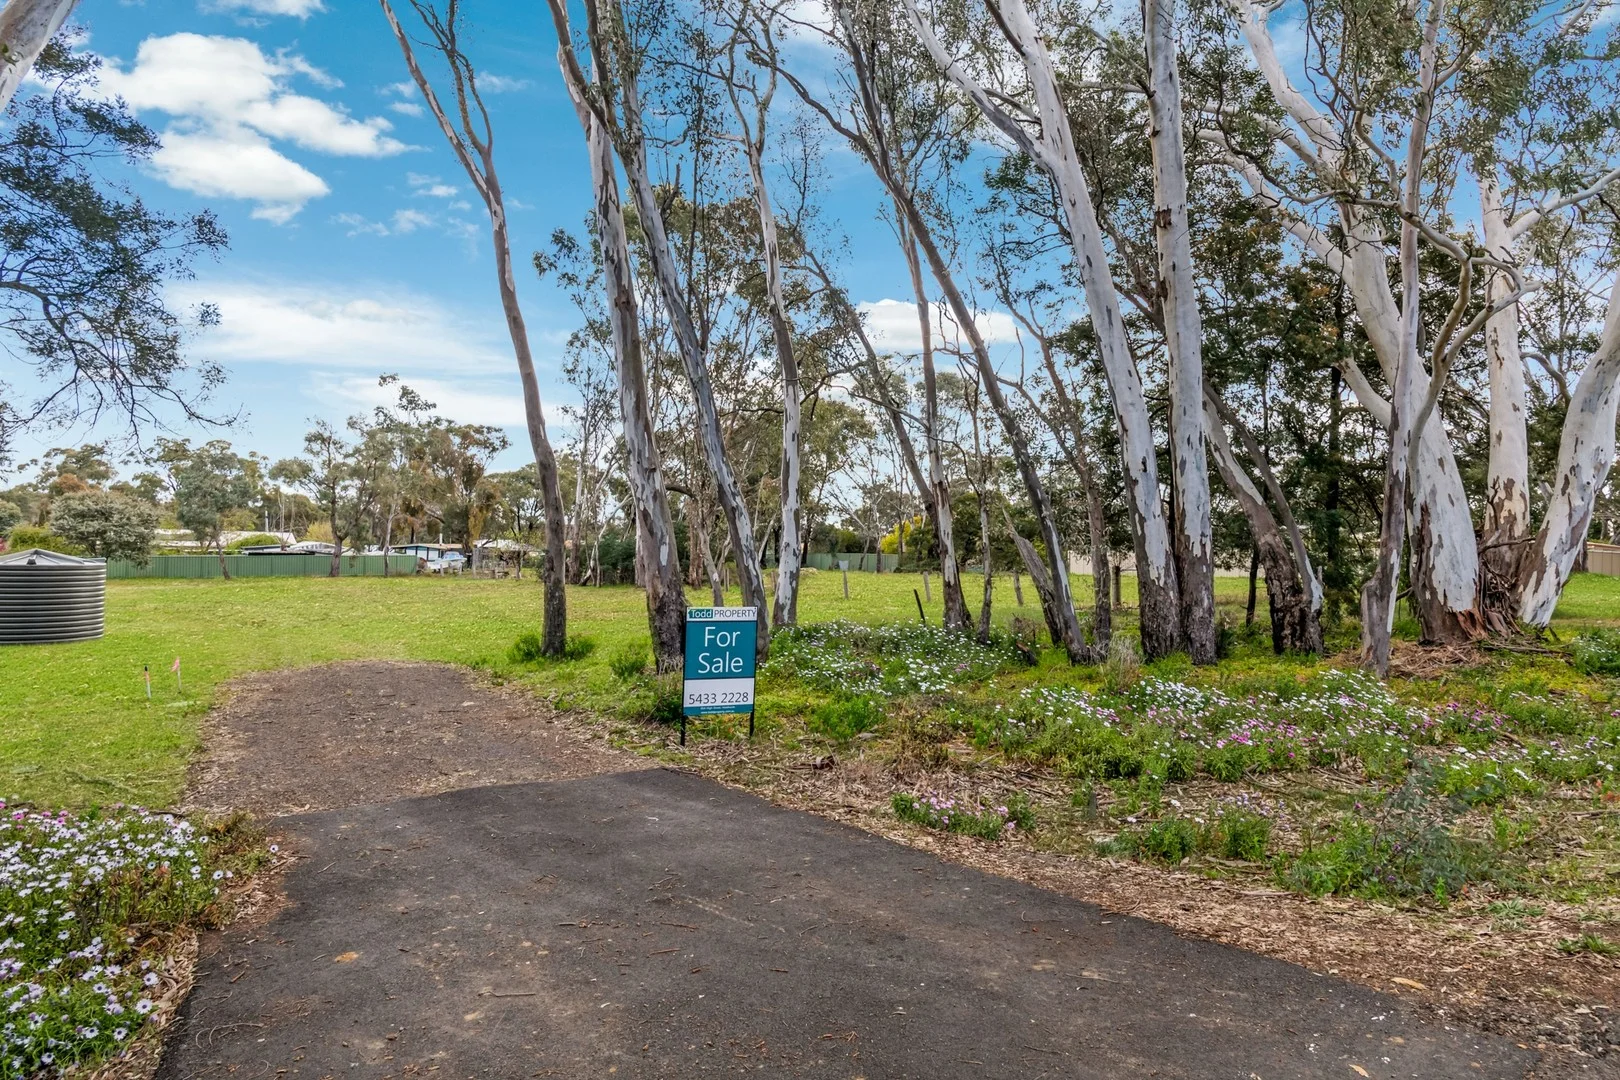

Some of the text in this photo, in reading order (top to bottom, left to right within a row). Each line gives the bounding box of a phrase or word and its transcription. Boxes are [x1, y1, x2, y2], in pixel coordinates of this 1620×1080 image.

[691, 609, 757, 617] Todd PROPERTY
[704, 626, 741, 647] For
[698, 651, 743, 673] Sale
[689, 692, 749, 704] 5433 2228
